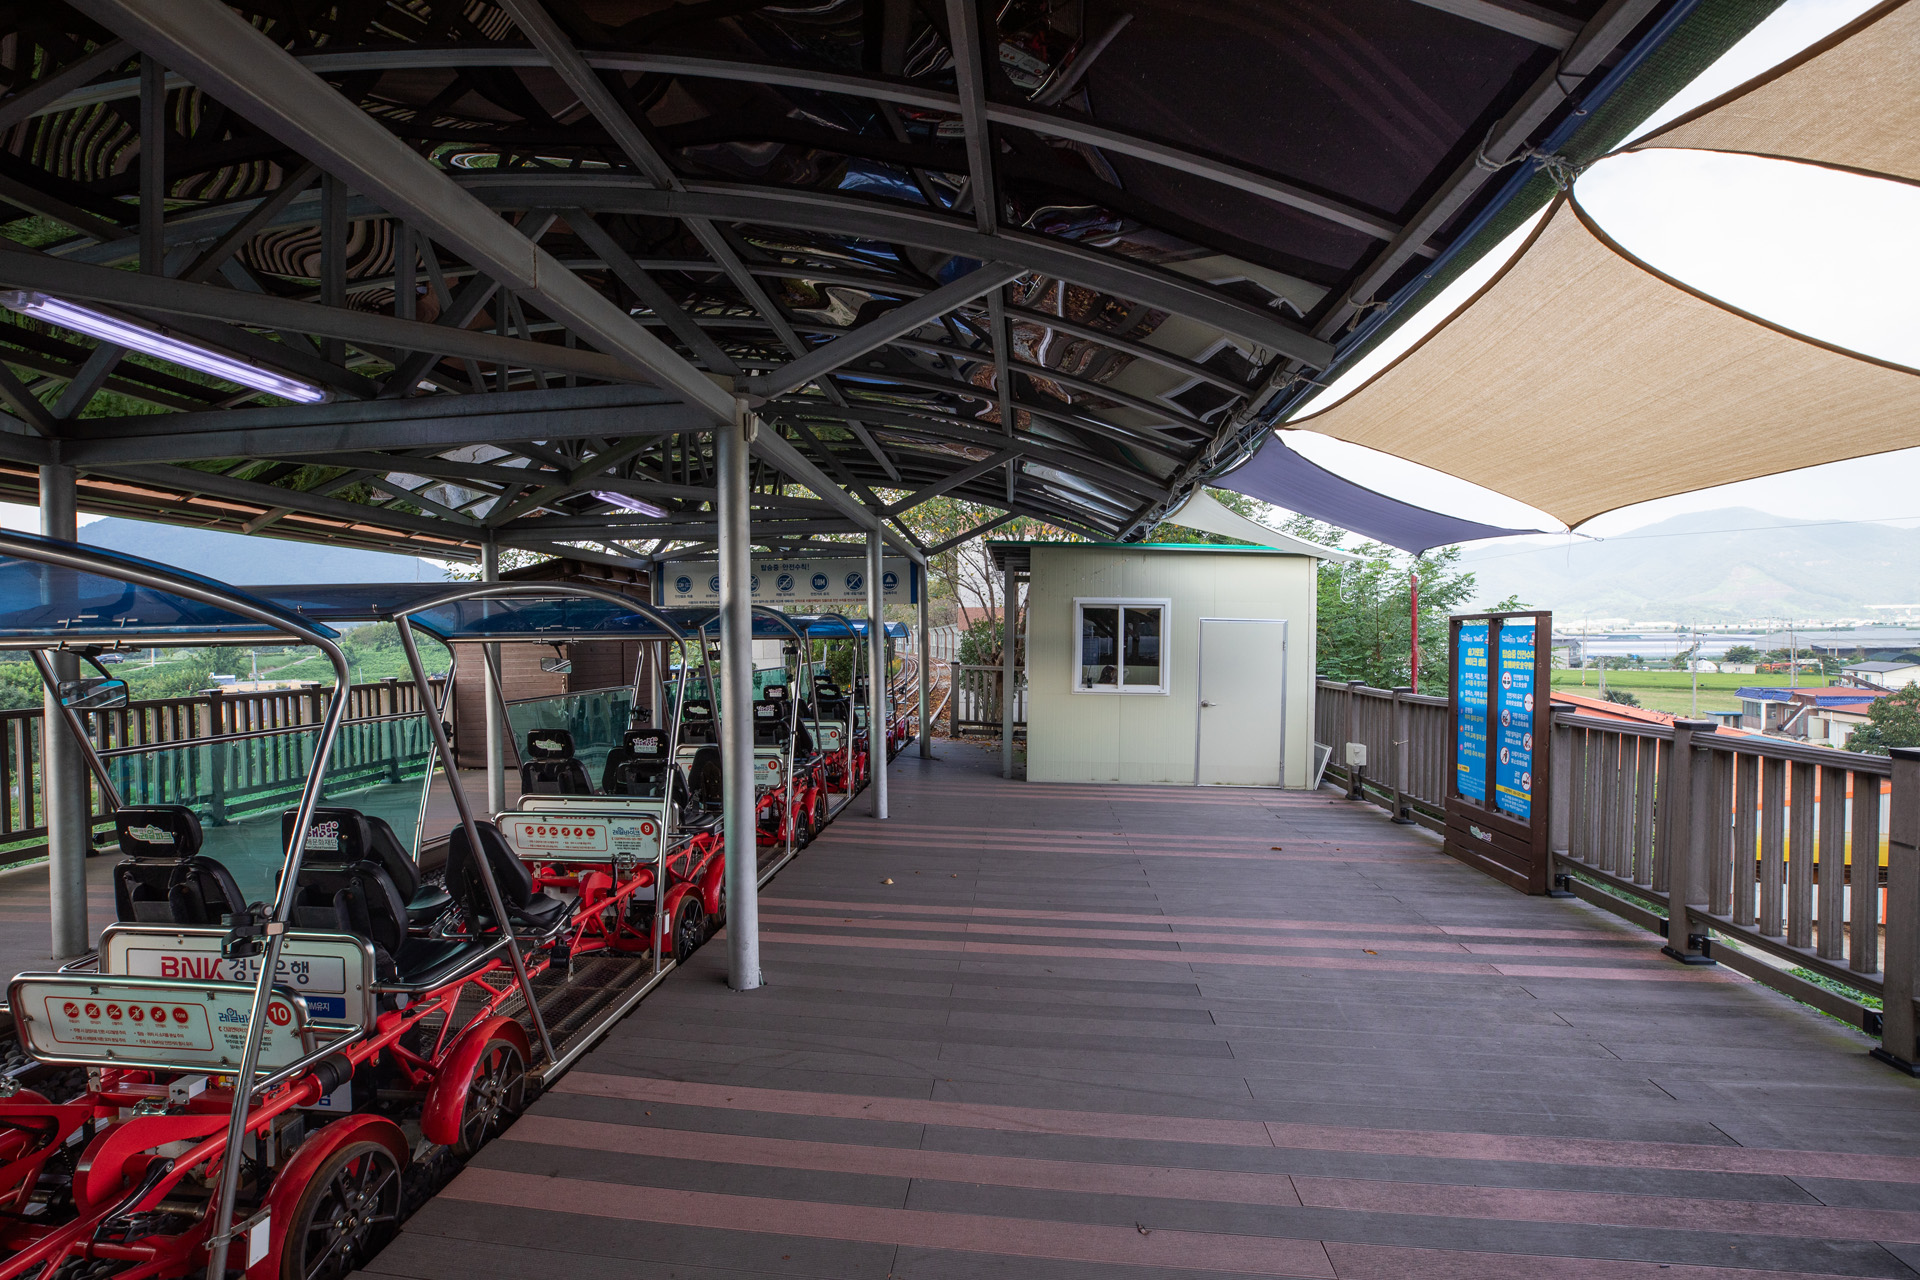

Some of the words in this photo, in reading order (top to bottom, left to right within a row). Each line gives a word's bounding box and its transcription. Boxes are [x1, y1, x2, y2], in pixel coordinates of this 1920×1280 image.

[782, 563, 810, 571] 안전수칙!
[644, 825, 650, 833] 9
[307, 838, 337, 847] 해문화재단
[161, 956, 224, 980] BNK
[270, 1006, 288, 1021] 10
